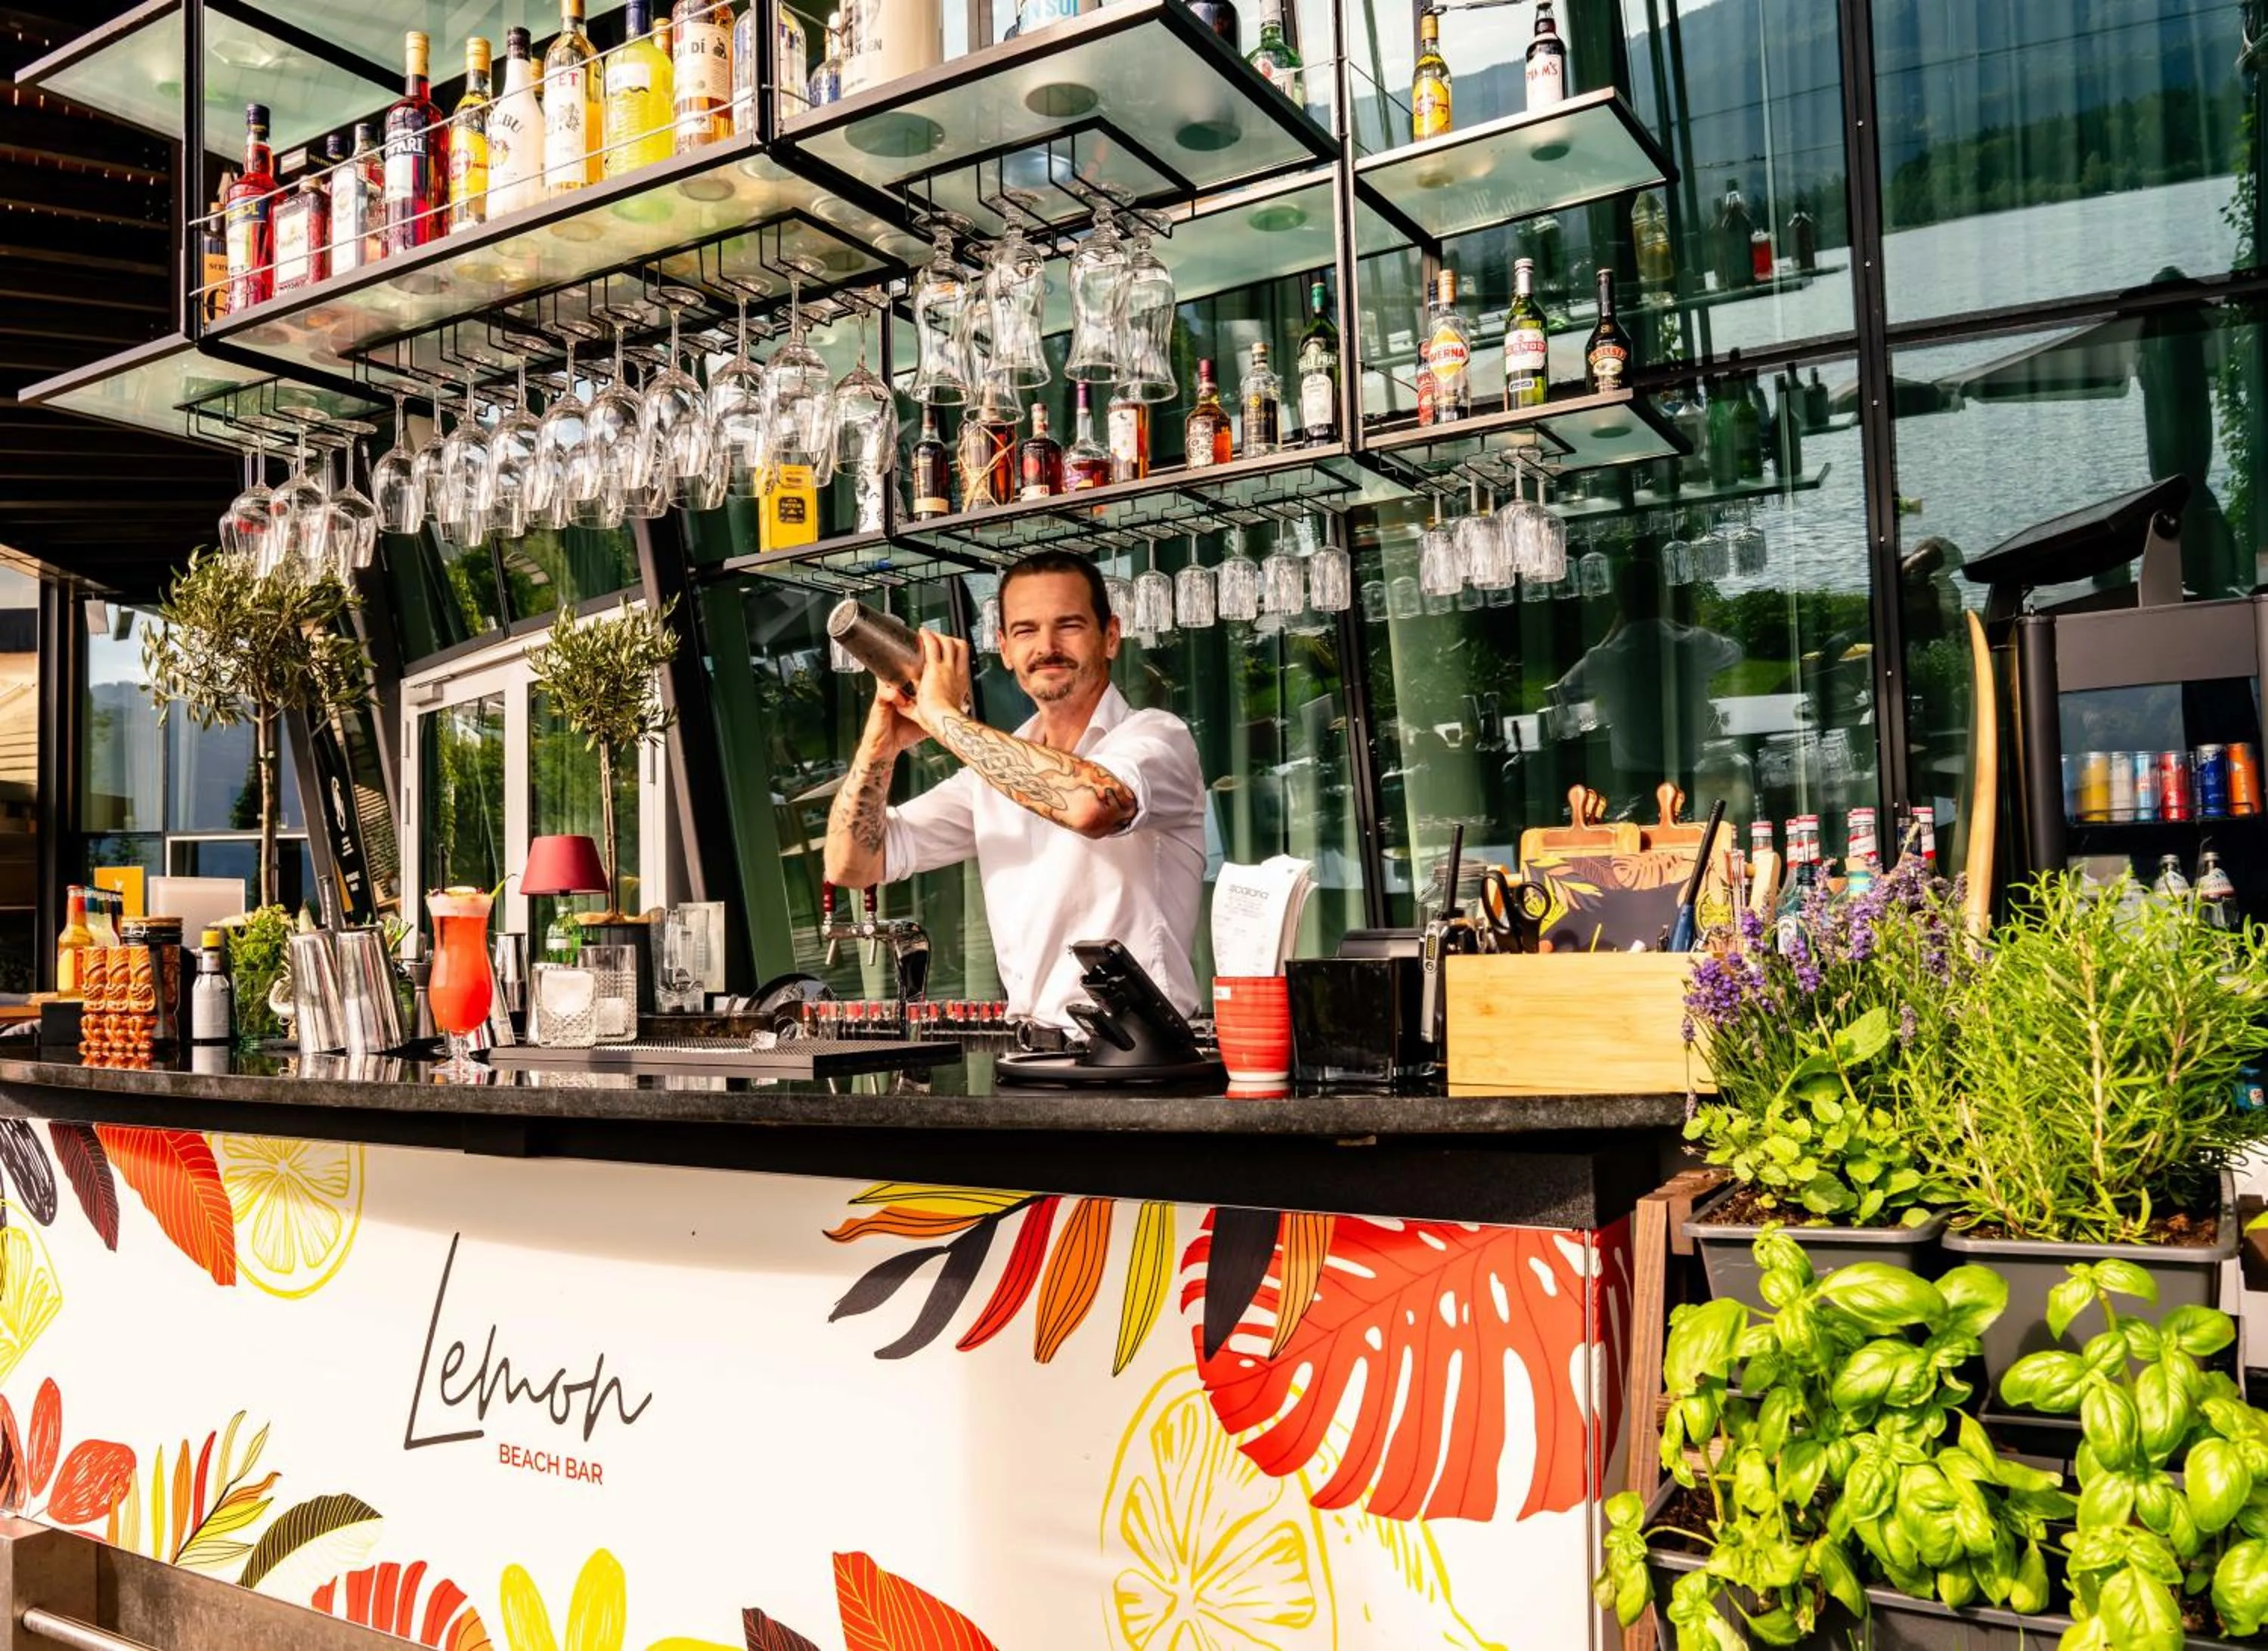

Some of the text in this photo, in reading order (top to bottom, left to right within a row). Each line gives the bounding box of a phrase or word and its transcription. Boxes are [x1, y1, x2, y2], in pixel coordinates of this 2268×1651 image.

[404, 1231, 652, 1451] Lemon
[499, 1443, 603, 1485] BEACH BAR
